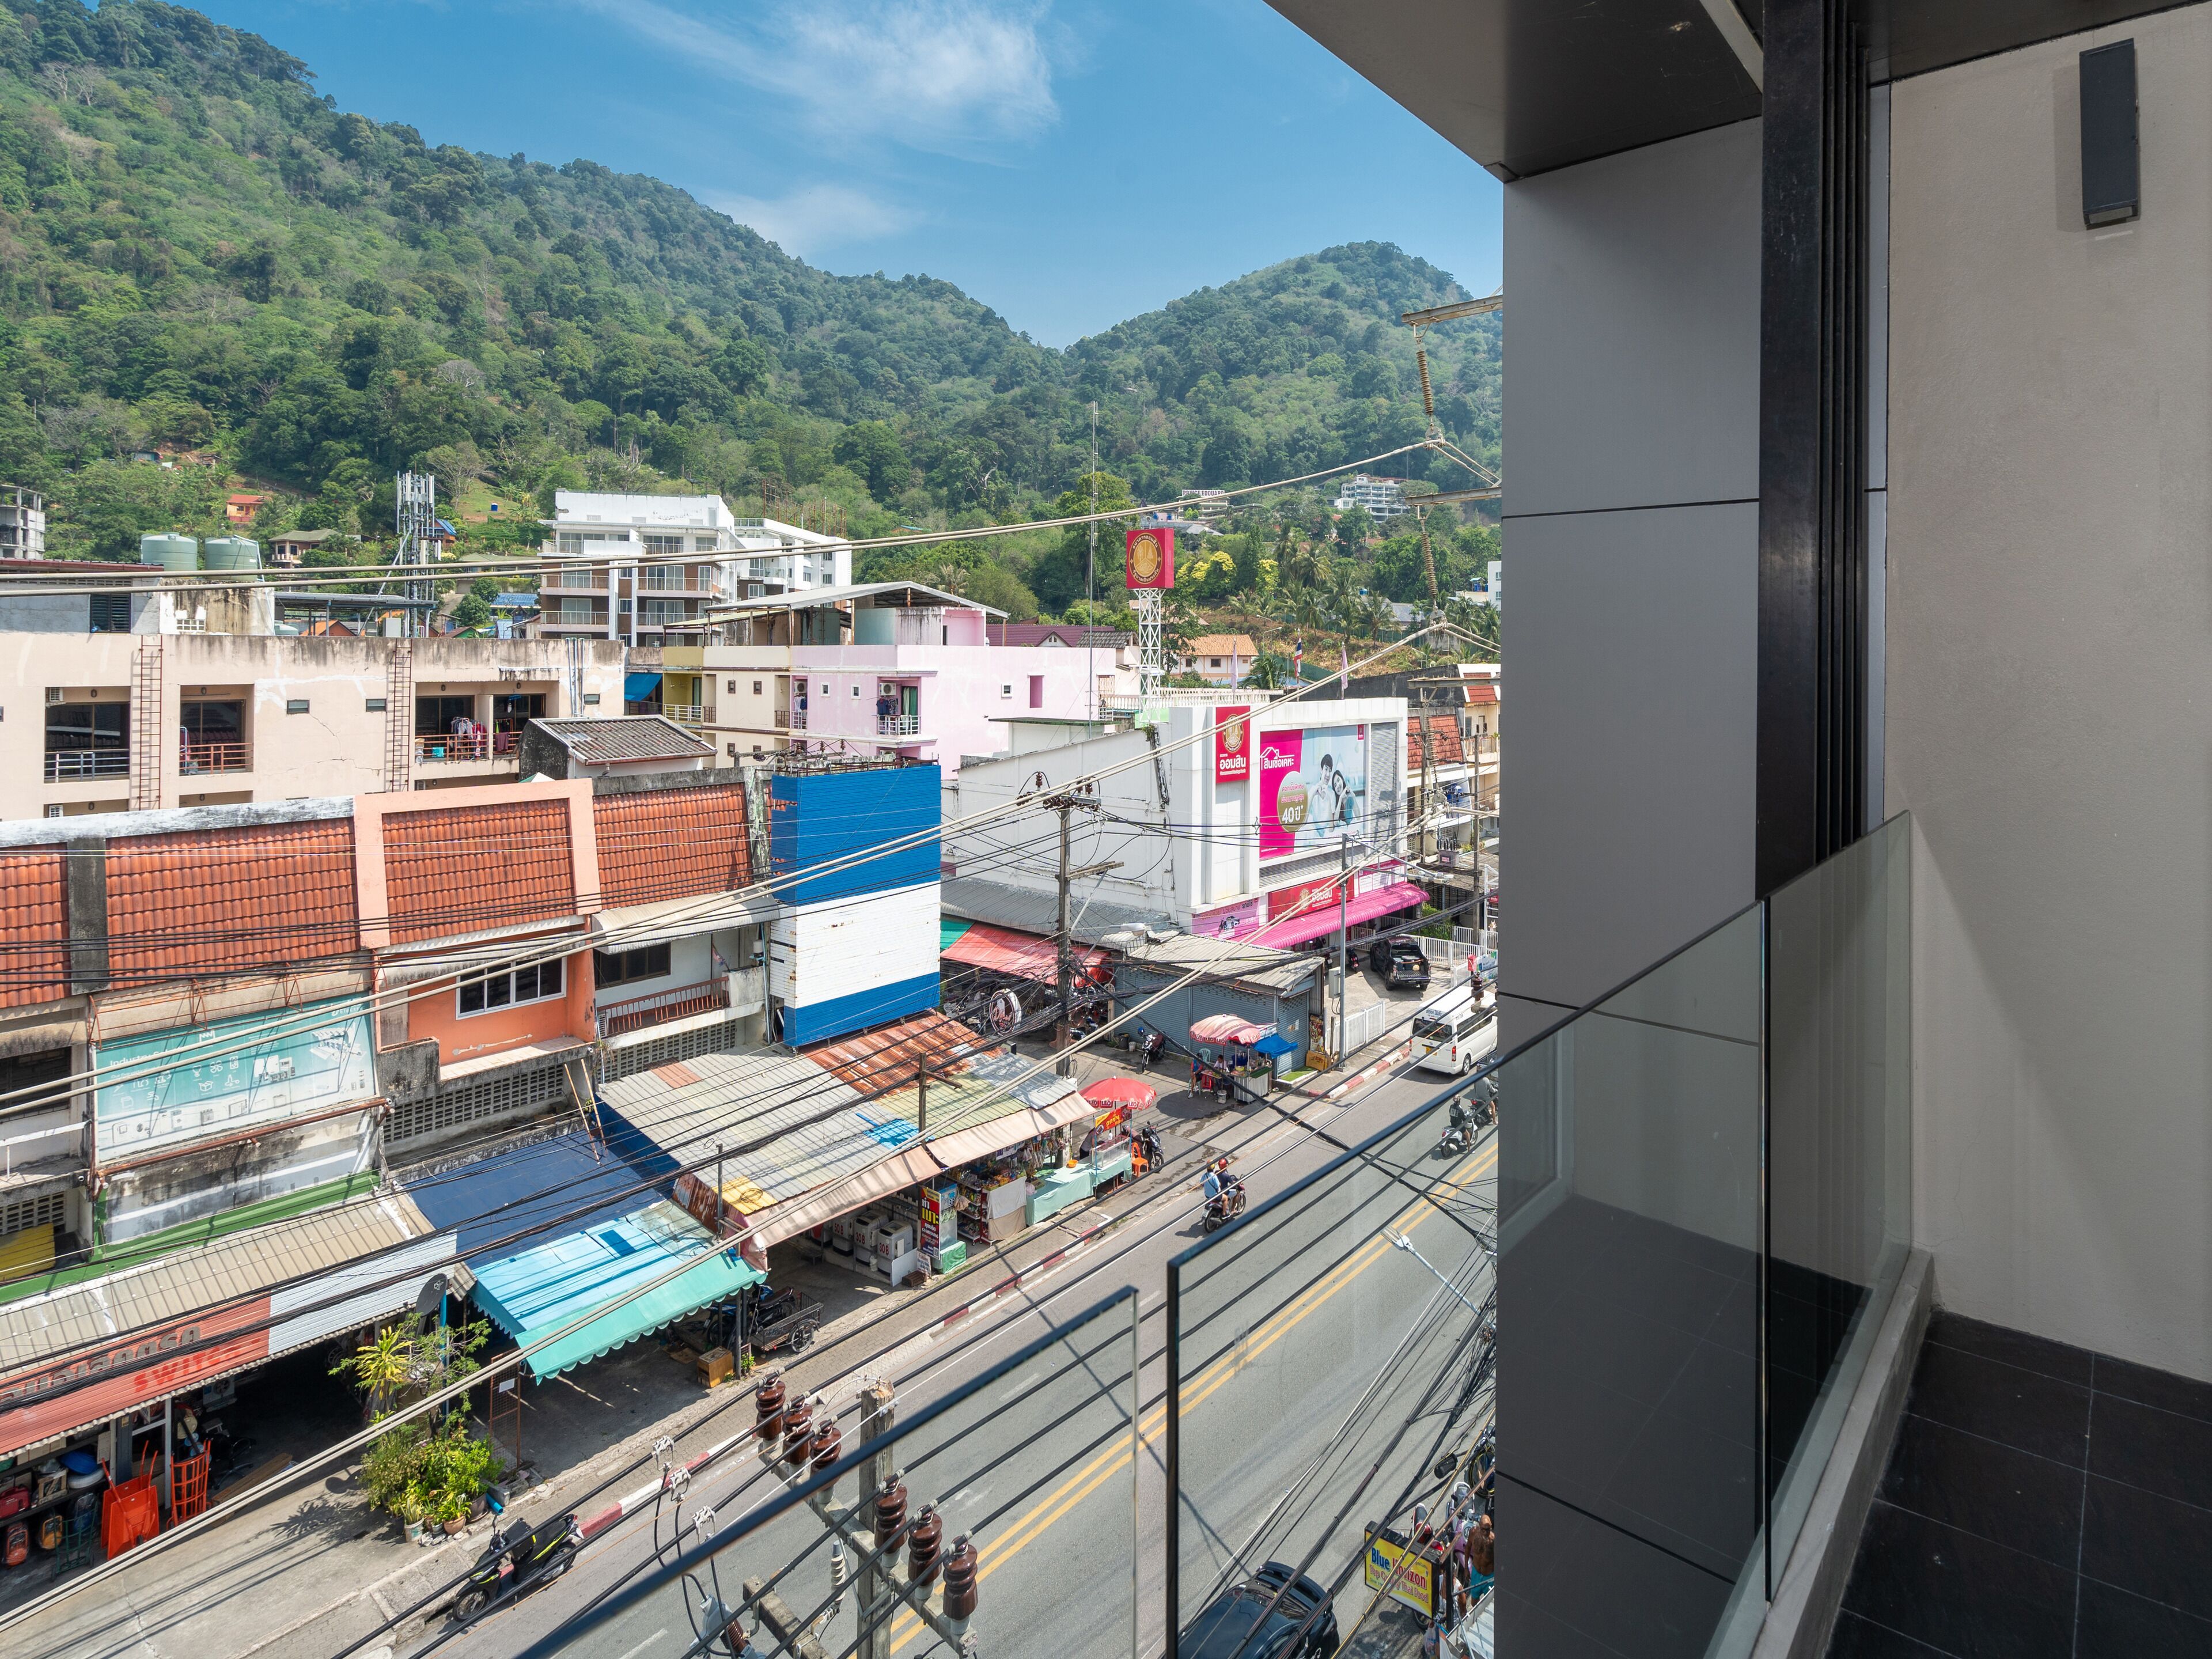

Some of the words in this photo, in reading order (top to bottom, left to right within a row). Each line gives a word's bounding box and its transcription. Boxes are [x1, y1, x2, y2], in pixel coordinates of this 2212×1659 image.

[1219, 754, 1247, 770] ออมสิน
[1263, 756, 1294, 770] สินเชื่อเคหะ
[879, 1243, 885, 1254] 30
[1371, 1547, 1391, 1571] Blue
[1369, 1564, 1380, 1580] Top
[1380, 1570, 1402, 1590] Quliy
[1401, 1581, 1414, 1596] Thai
[1414, 1588, 1429, 1603] Food
